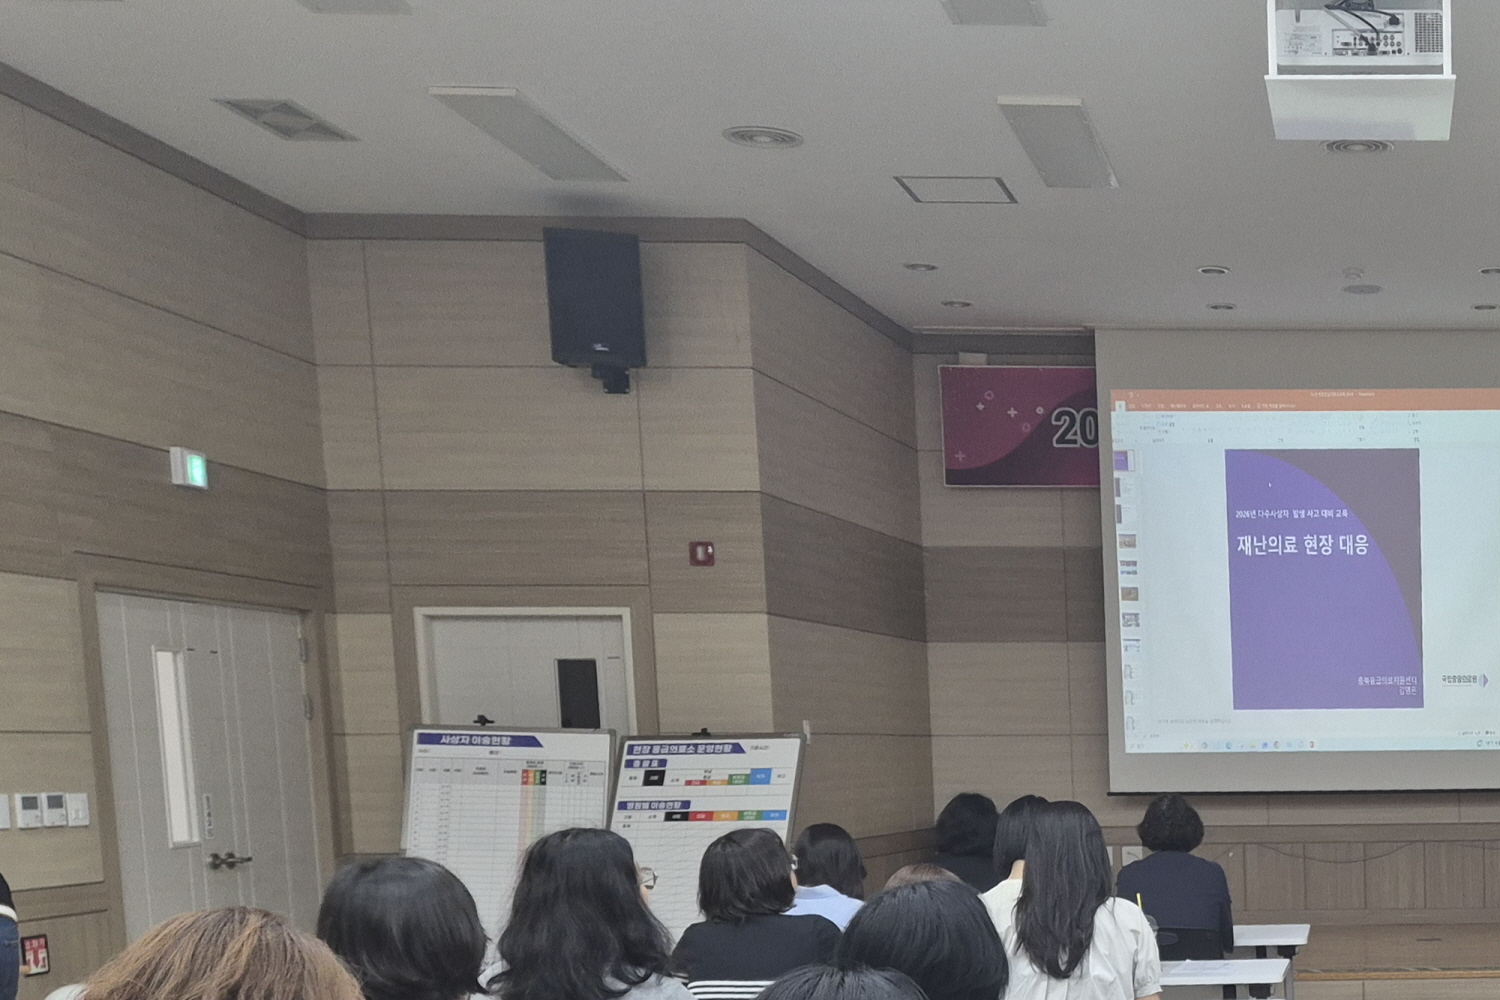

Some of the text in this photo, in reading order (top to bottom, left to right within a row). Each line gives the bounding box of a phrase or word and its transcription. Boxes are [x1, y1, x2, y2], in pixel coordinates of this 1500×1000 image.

[1235, 509, 1256, 519] 2026년
[1257, 509, 1289, 519] 다수사상자
[1306, 509, 1319, 518] 사고
[1320, 509, 1334, 519] 대비
[1335, 508, 1348, 518] 교육
[1237, 534, 1369, 556] 재난의료 현장 대응
[440, 734, 512, 746] 사상자 이송현황
[632, 743, 733, 755] 현장 응급의료소 운영현황
[626, 801, 682, 810] 병원별 이송현황
